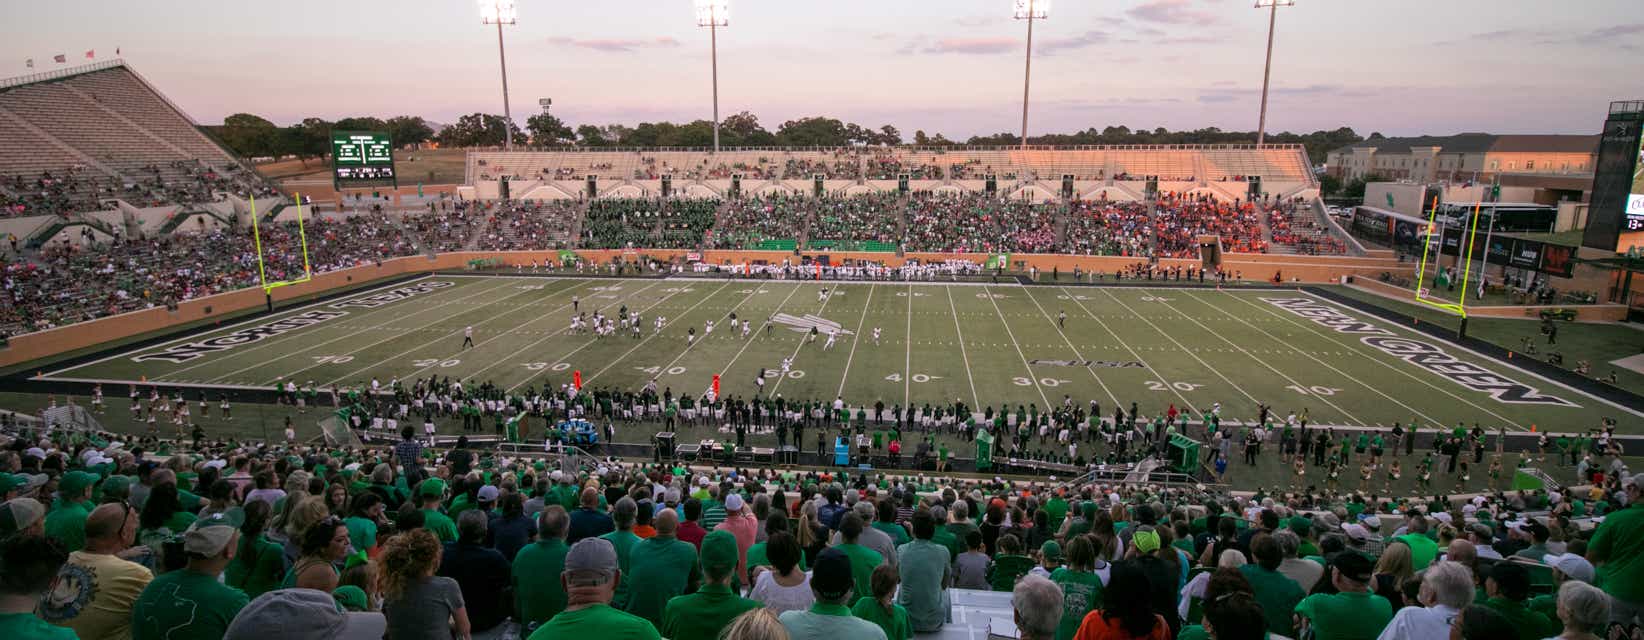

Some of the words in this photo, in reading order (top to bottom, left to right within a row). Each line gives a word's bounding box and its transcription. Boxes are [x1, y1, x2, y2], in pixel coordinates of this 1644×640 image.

[131, 311, 350, 363] NORTH
[328, 281, 455, 308] TEXAS
[1256, 297, 1399, 336] MEAN
[1360, 336, 1584, 408] GREEN
[414, 358, 461, 368] 20
[527, 362, 571, 371] 30
[643, 366, 687, 375] 40
[764, 369, 805, 379] 50
[885, 373, 930, 383] 40
[1012, 376, 1060, 387] 30
[1144, 380, 1195, 391] 20
[1284, 385, 1335, 396] 10
